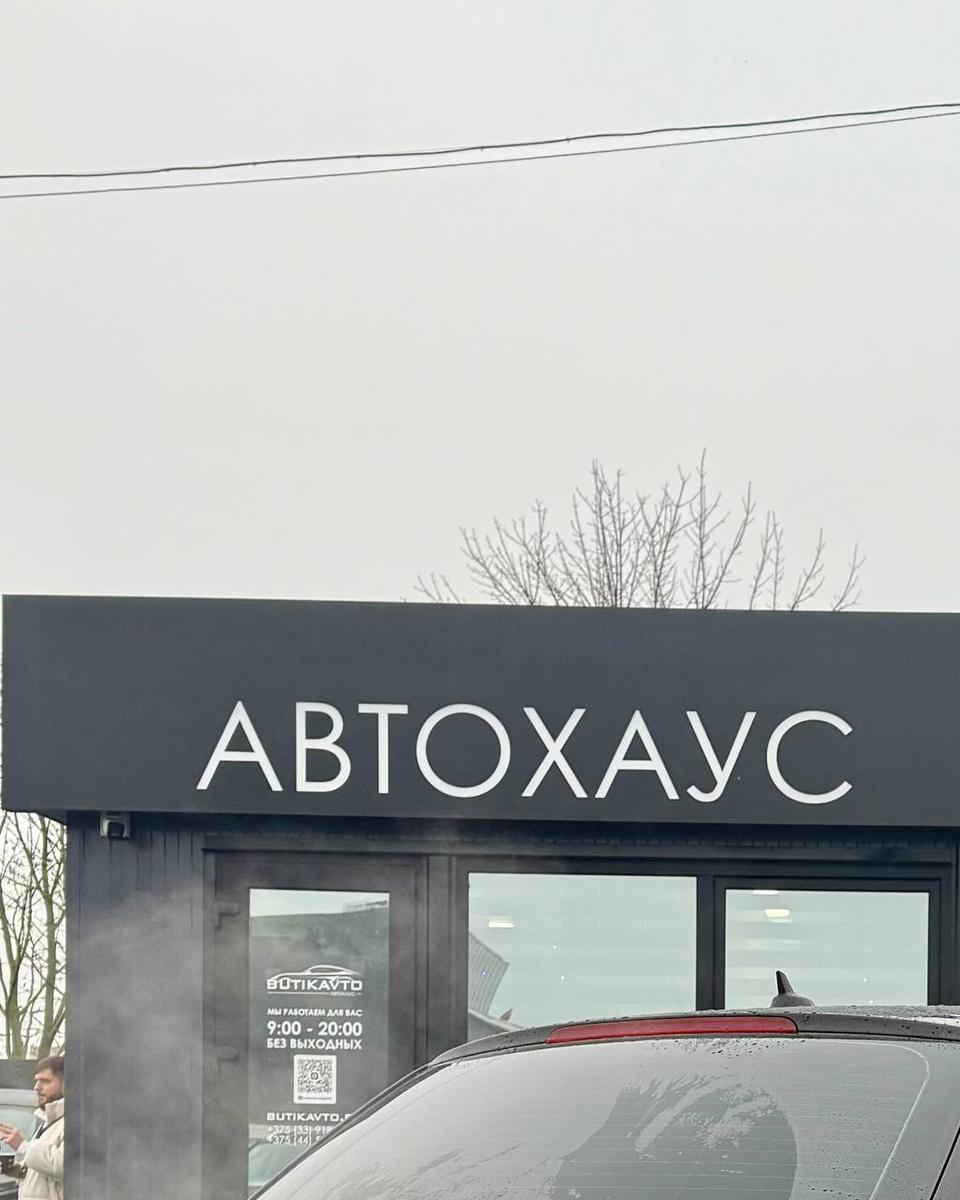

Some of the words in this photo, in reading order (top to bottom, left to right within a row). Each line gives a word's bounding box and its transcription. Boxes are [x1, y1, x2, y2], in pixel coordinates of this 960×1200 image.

[196, 699, 856, 804] АВТОХАУС
[266, 978, 363, 991] BUTIKAVTO
[267, 1008, 281, 1016] МЫ
[283, 1008, 326, 1016] РАБОТАЕМ
[327, 1009, 344, 1017] ДЛЯ
[346, 1009, 363, 1017] ВАС
[267, 1021, 302, 1036] 9:00
[318, 1021, 363, 1036] 20:00
[266, 1038, 287, 1049] БЕЗ
[290, 1038, 363, 1050] ВЫХОДНЫХ
